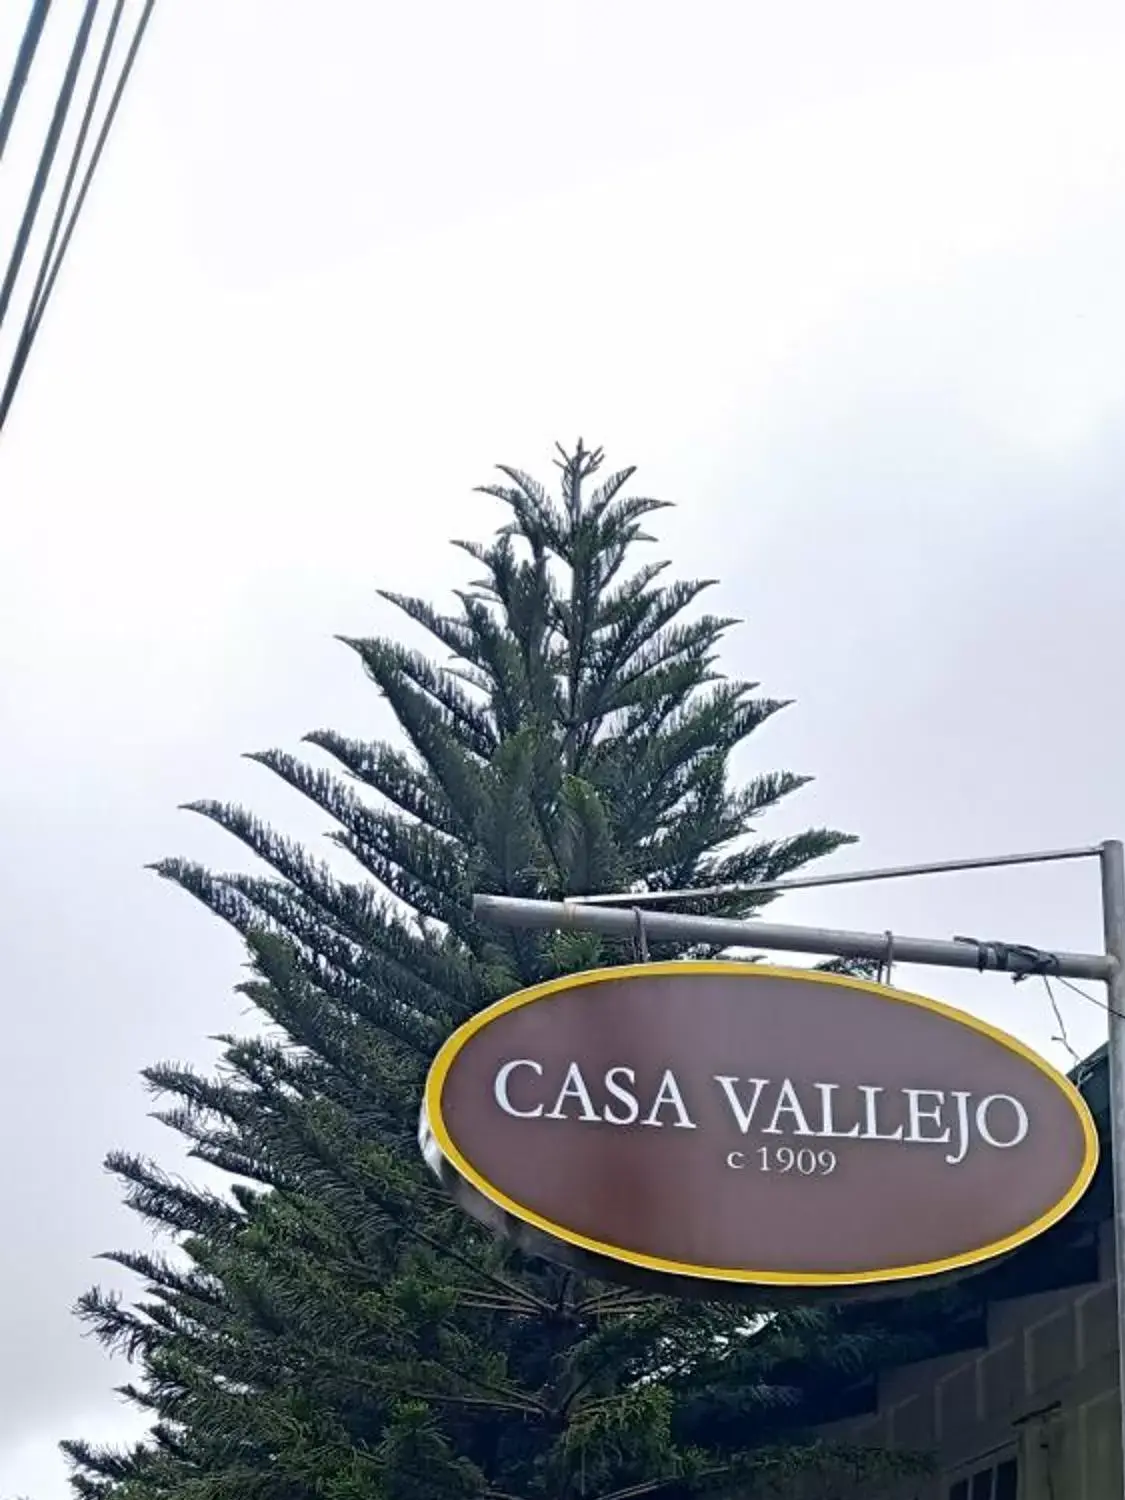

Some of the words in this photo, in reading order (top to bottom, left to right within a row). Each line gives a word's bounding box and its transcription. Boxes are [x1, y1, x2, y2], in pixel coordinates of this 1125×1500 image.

[494, 1058, 698, 1130] CASA
[713, 1075, 1030, 1164] VALLEJO
[726, 1151, 745, 1170] c
[757, 1146, 838, 1176] 1909
